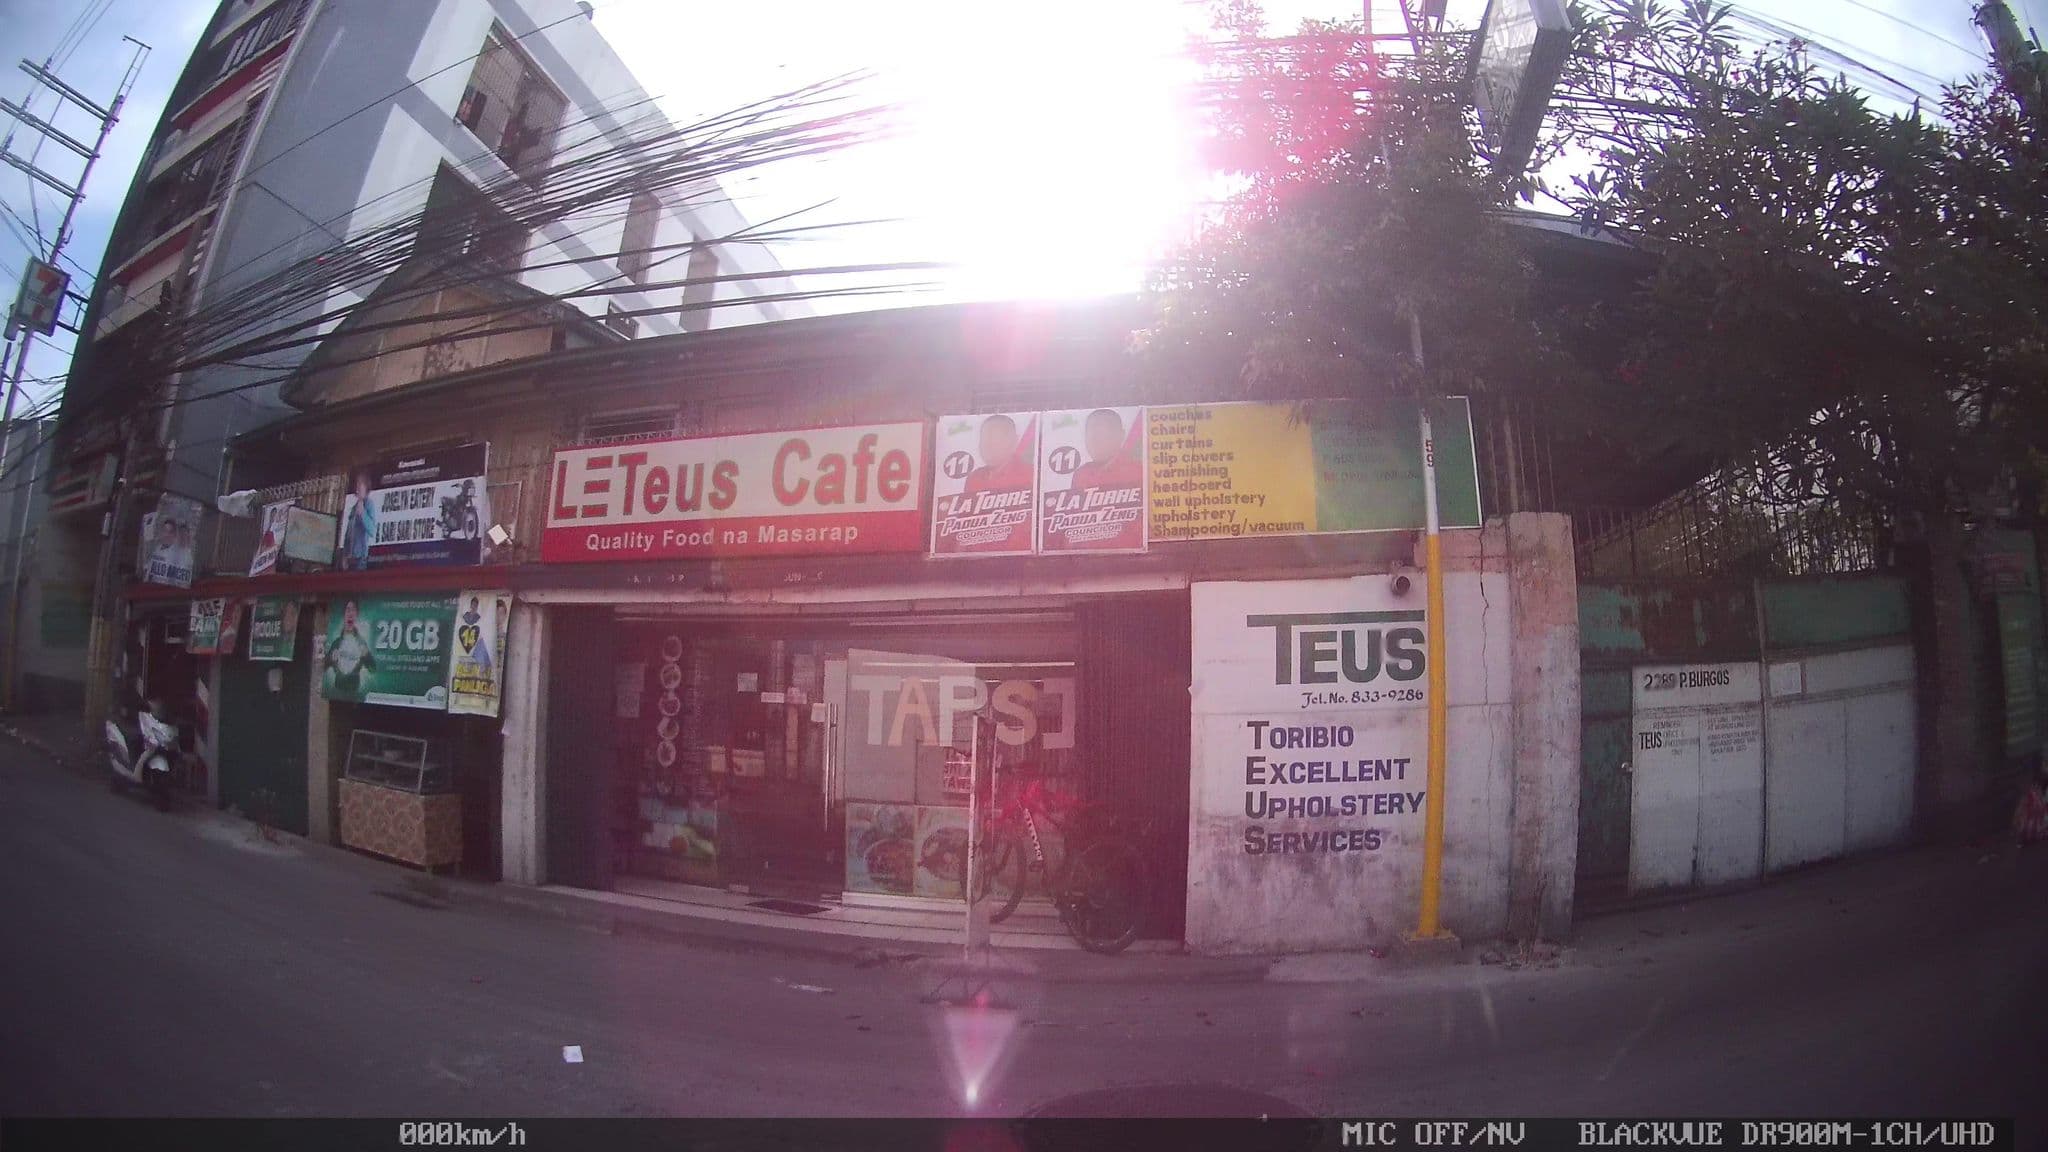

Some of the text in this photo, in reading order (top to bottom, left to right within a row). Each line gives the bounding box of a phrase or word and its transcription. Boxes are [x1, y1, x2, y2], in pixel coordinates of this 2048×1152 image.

[1151, 410, 1212, 422] couches
[1151, 424, 1196, 436] chairs
[1152, 438, 1213, 450] curtains
[946, 454, 969, 476] 11
[1051, 450, 1075, 471] 11
[1152, 451, 1234, 467] slip covers
[772, 433, 912, 507] Cafe
[1154, 465, 1228, 478] varnishing
[1153, 478, 1231, 493] headboard
[1153, 493, 1265, 509] wall upholstery
[1153, 509, 1236, 522] upholstery
[413, 517, 435, 539] STORE
[957, 526, 1011, 540] COUNCILOR
[1066, 523, 1121, 538] COUNCILOR
[586, 525, 859, 552] Quality Food na Masarap
[376, 620, 440, 650] 20 GB
[1247, 609, 1426, 685] TEUS
[1351, 689, 1424, 703] 833-9286
[1247, 720, 1354, 750] TORIBIO
[1638, 731, 1663, 750] TEUS
[1246, 756, 1411, 785] EXCELLENT
[1245, 791, 1426, 819] UPHOLSTERY
[1244, 826, 1382, 855] SERVICES
